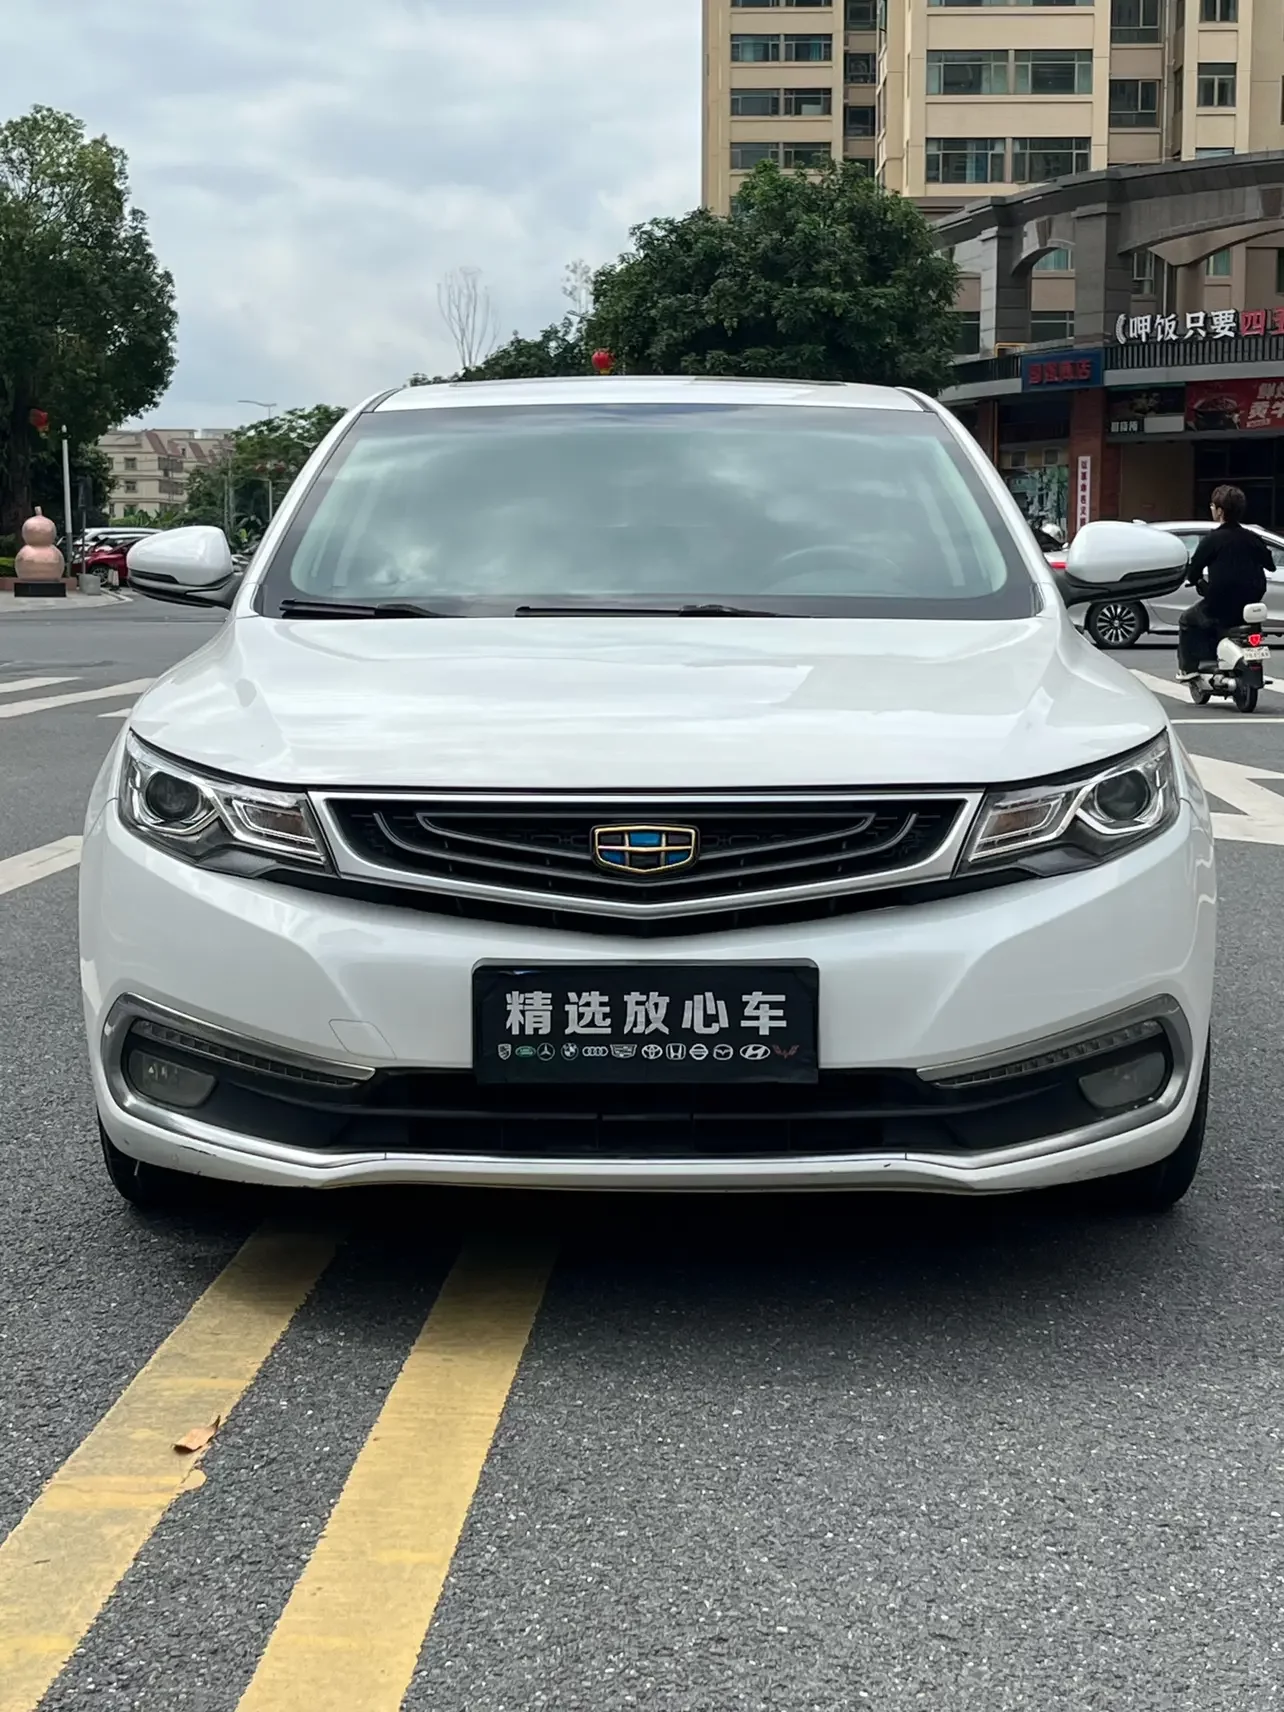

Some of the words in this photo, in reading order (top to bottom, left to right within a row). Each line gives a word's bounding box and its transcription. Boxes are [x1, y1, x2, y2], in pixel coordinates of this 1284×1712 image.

[505, 991, 787, 1036] 精选放心车
